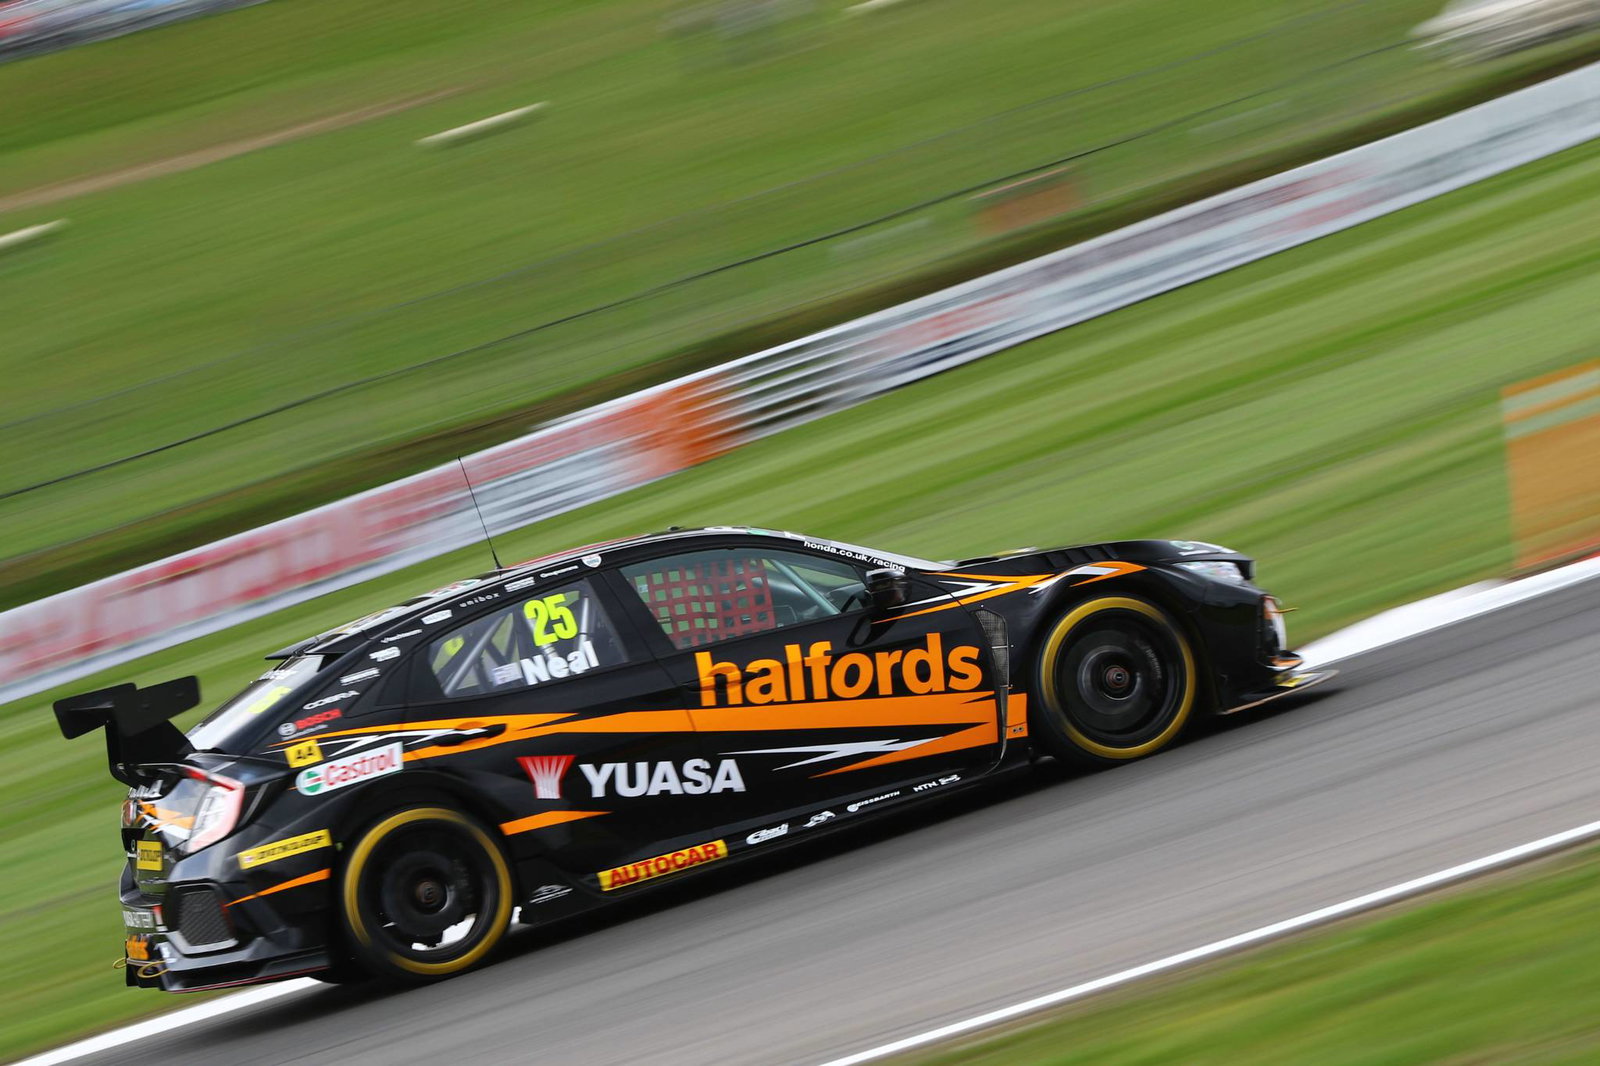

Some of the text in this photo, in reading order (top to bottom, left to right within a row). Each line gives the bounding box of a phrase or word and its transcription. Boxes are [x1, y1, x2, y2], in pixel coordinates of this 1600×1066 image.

[804, 541, 906, 572] honda.co.uk/racing
[459, 593, 499, 608] unibox
[523, 594, 578, 646] 25
[520, 640, 600, 686] Neal
[695, 633, 983, 707] halfords
[294, 708, 343, 730] BOSCH
[303, 690, 360, 709] COBRA
[294, 744, 314, 763] AA
[324, 748, 397, 787] Castrol
[579, 759, 746, 798] YUASA
[609, 843, 721, 888] AUTOCAR
